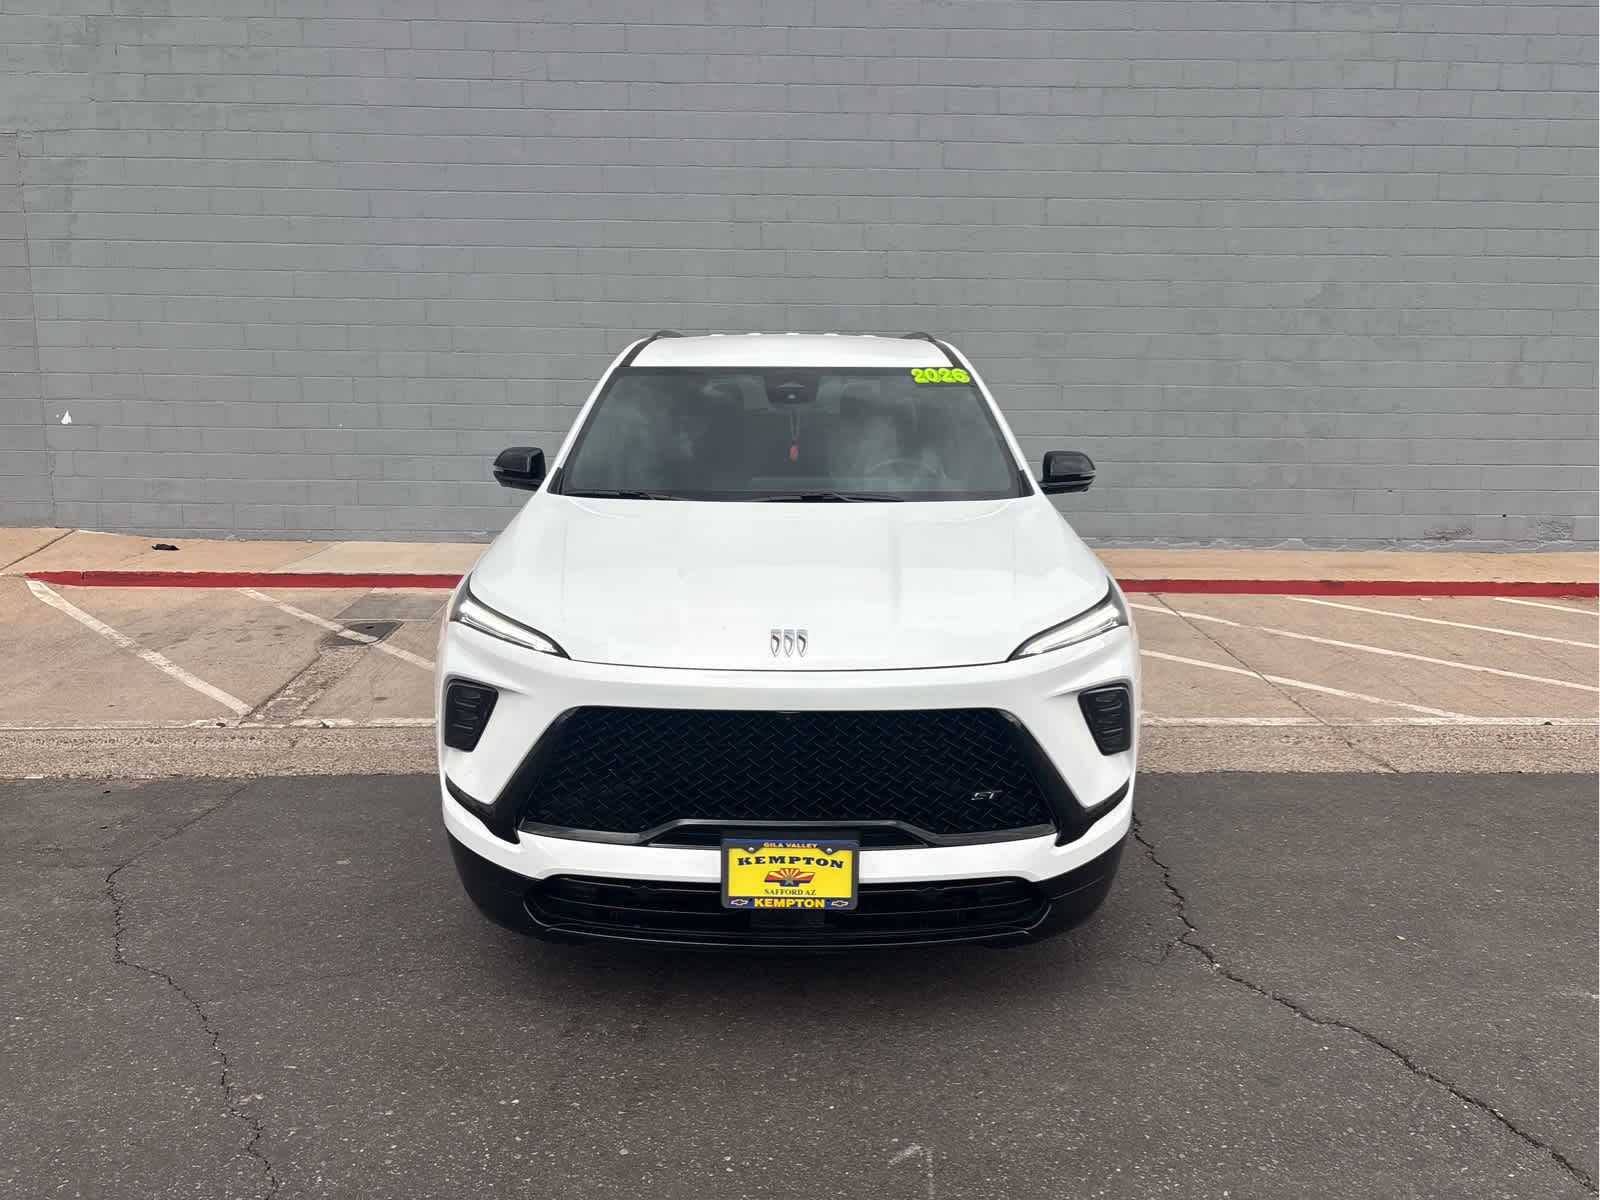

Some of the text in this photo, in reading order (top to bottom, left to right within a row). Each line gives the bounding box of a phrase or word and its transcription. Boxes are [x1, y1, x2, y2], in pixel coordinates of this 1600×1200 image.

[911, 368, 970, 383] 2026
[737, 856, 844, 868] KEMPTON
[754, 898, 825, 907] KEMPTON
